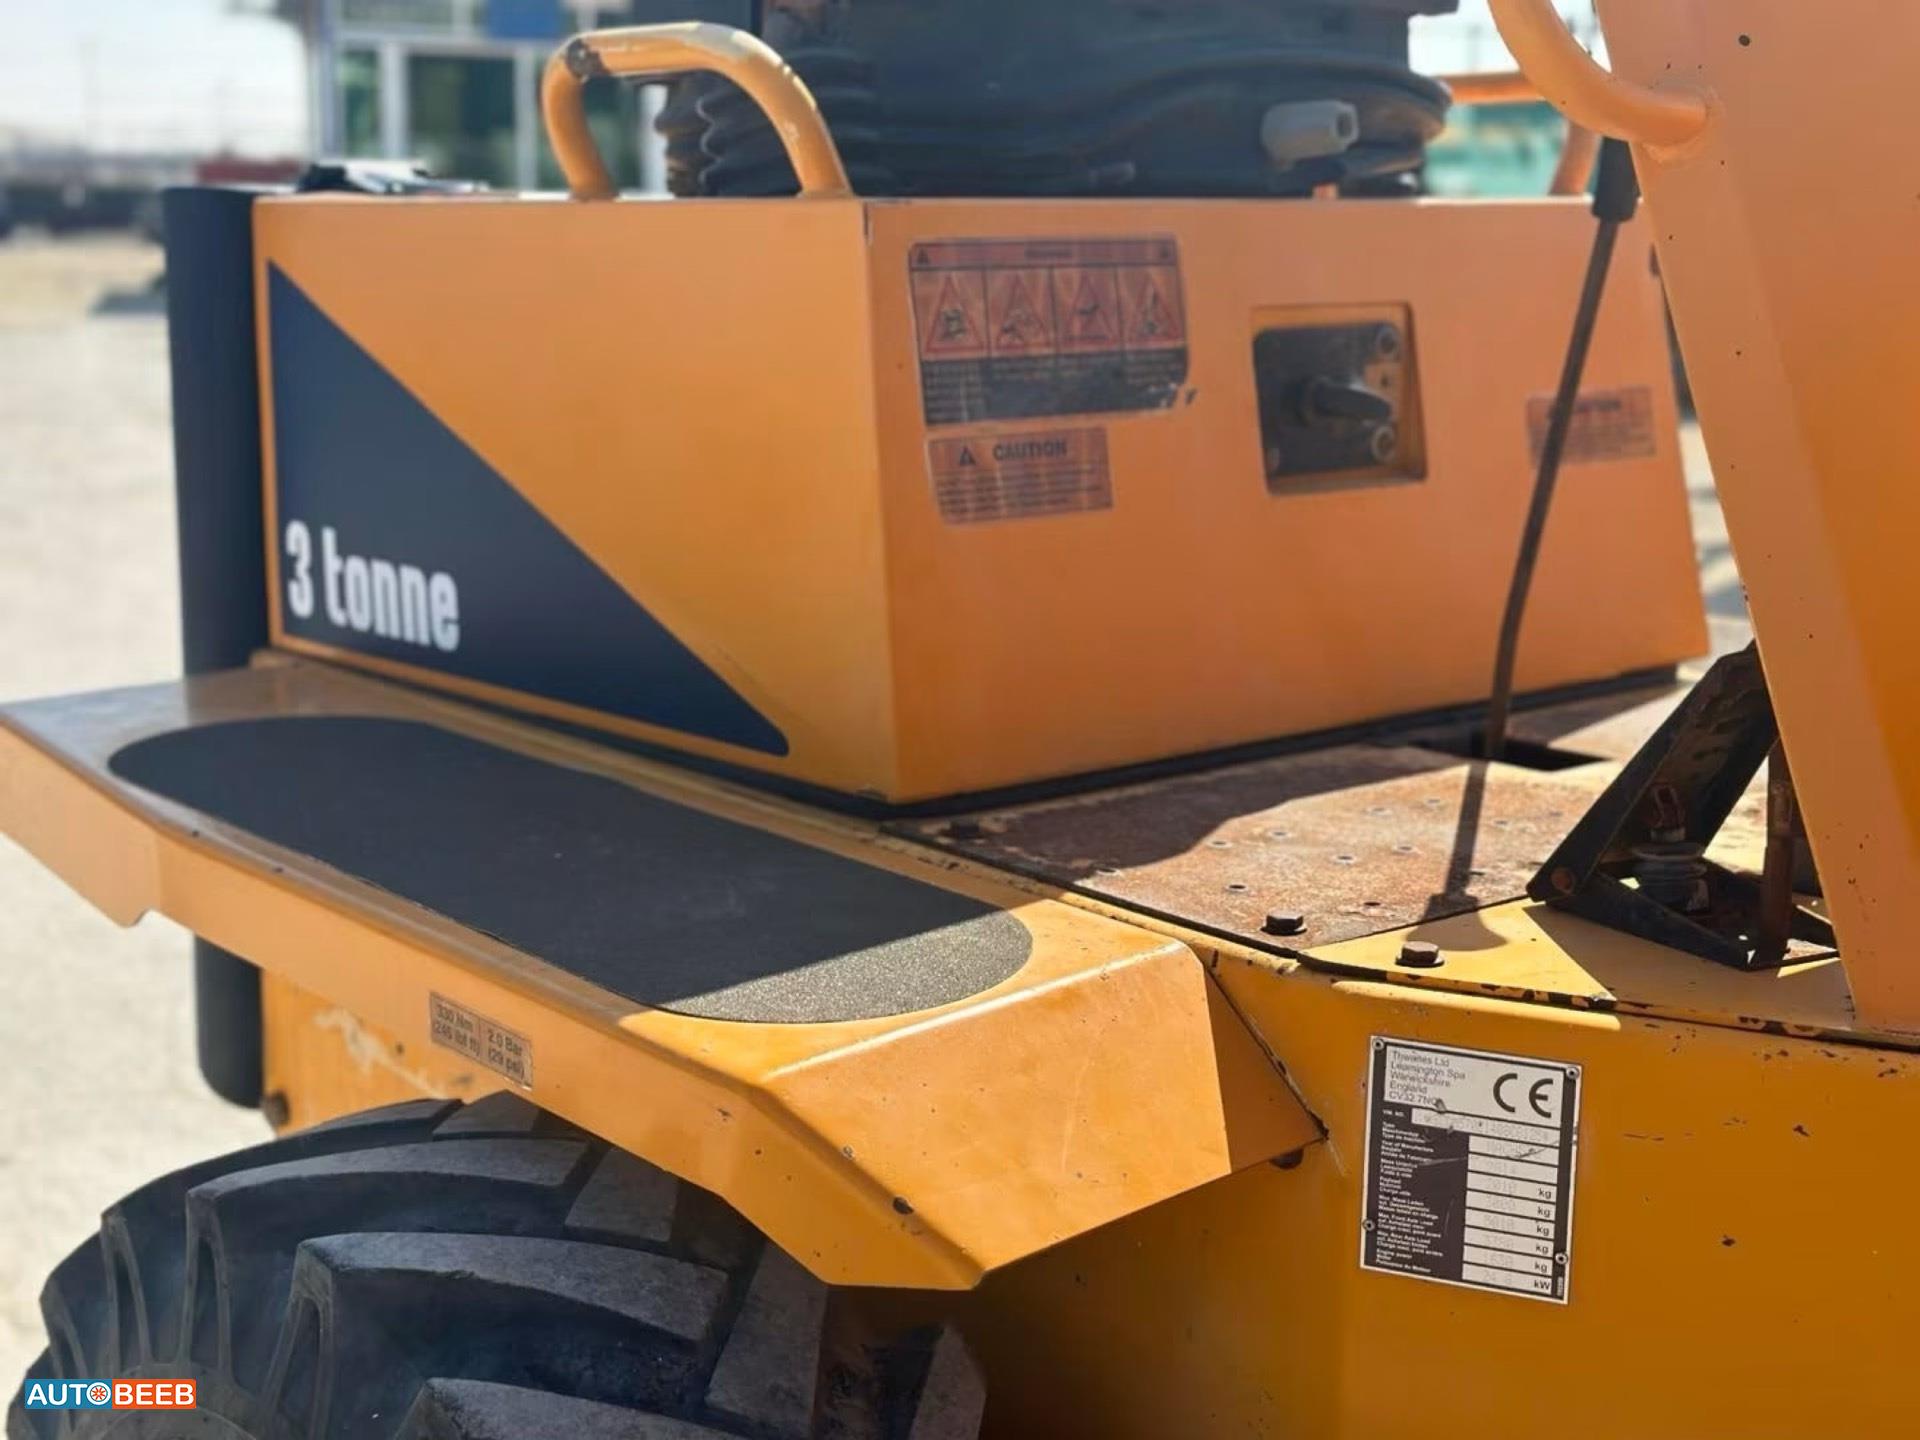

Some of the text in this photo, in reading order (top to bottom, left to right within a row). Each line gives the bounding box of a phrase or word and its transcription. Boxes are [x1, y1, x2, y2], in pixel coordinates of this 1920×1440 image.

[993, 439, 1067, 460] CAUTION
[286, 520, 459, 653] 3 tonne
[488, 1028, 522, 1056] 2.0 Bar
[1434, 1056, 1449, 1067] Ltd
[1390, 1060, 1465, 1081] Leamington Spa
[1389, 1080, 1427, 1095] England
[1537, 1186, 1552, 1199] kg
[1536, 1204, 1551, 1217] kg
[1535, 1222, 1550, 1236] kg
[1534, 1242, 1549, 1254] kg
[1533, 1259, 1548, 1273] kg
[1532, 1277, 1550, 1291] kW
